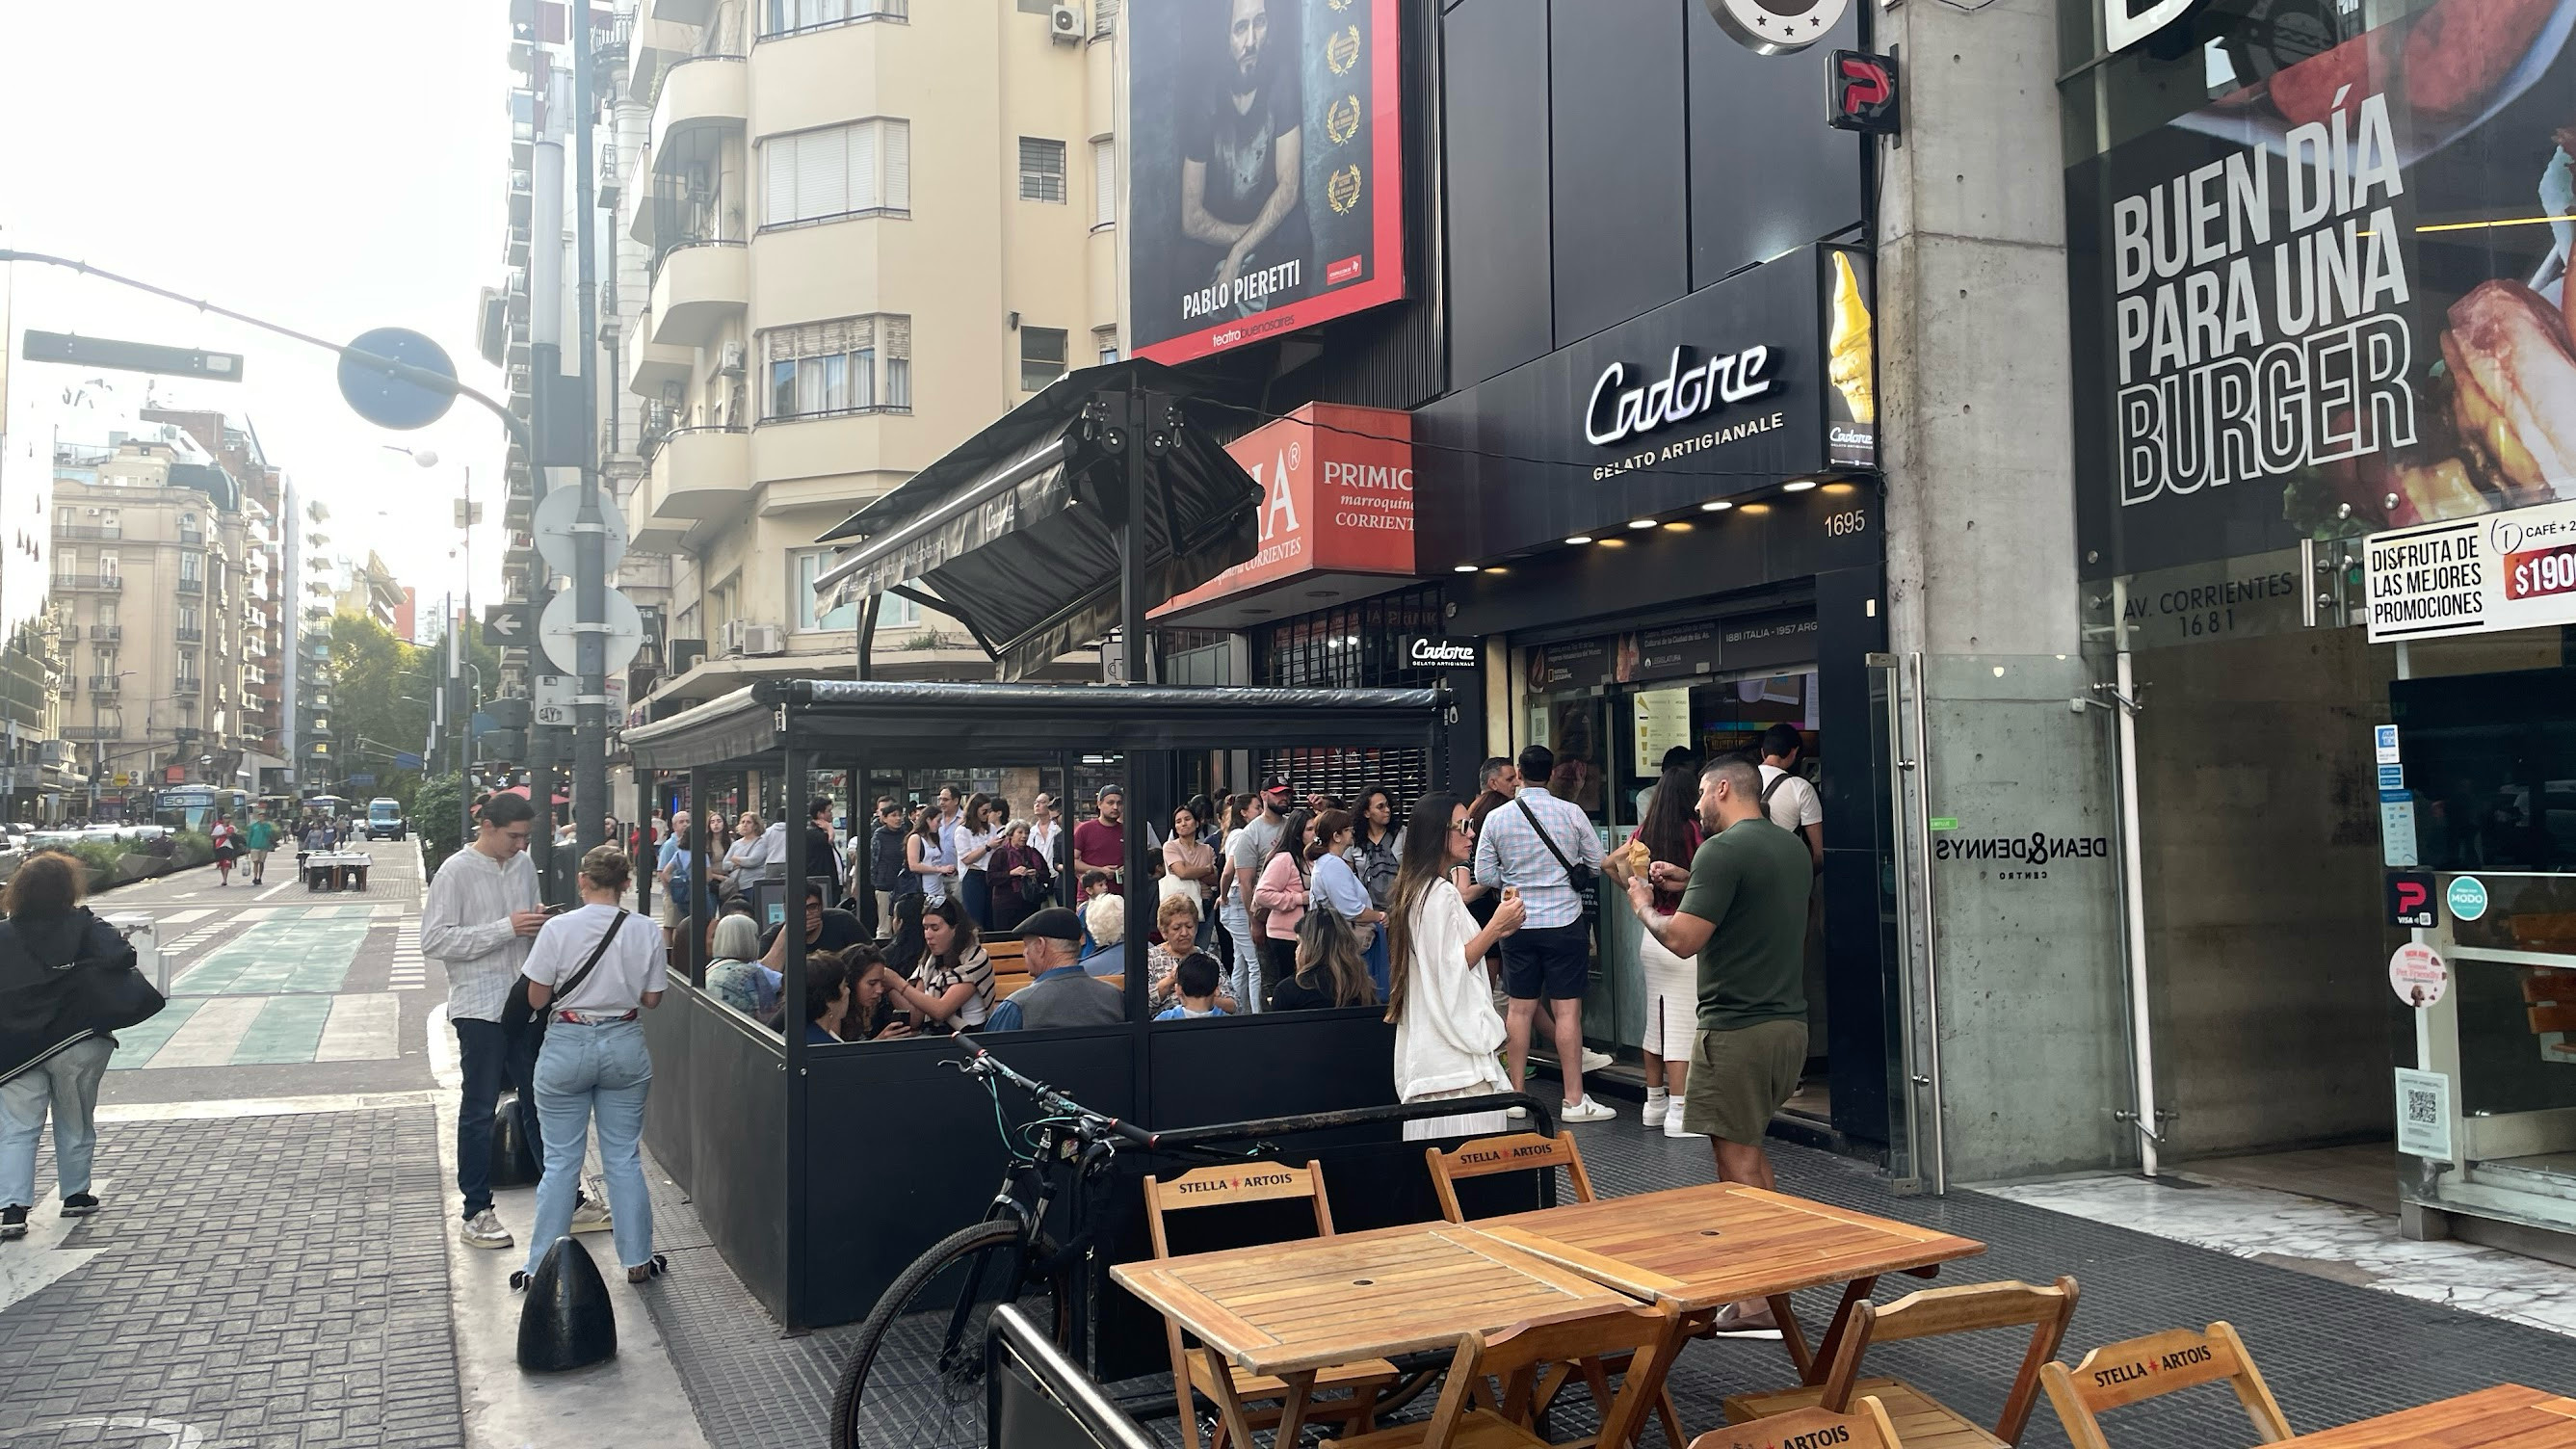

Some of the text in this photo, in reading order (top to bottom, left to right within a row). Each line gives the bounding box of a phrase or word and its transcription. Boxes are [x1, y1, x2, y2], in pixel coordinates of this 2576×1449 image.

[2114, 84, 2404, 294] BUEN DÍA
[1183, 258, 1301, 320] PABLO PIERETTI
[2117, 206, 2409, 384] PARA UNA
[1585, 345, 1771, 445] Cadore
[2117, 313, 2418, 506] BURGER
[1592, 411, 1784, 481] GELATO ARTIGIANALE
[1830, 426, 1874, 444] Cadore
[1324, 461, 1414, 490] PRIMIC
[1824, 509, 1866, 538] 1695
[2526, 523, 2558, 538] CAFÉ
[2372, 535, 2479, 572] DISFRUTA DE
[2123, 571, 2294, 620] AV. CORRIENTES
[2374, 562, 2482, 598] LAS MEJORES
[2375, 591, 2483, 624] PROMOCIONES
[1743, 628, 1770, 640] ITALIA
[1776, 624, 1796, 636] 1957
[1798, 621, 1818, 632] ARG
[2179, 609, 2234, 638] 1681
[1411, 638, 1475, 661] Cadore
[2451, 893, 2484, 904] MODO
[1460, 1144, 1553, 1165] STELLA ARTOIS
[1179, 1173, 1293, 1195] STELLA ARTOIS
[2094, 1345, 2212, 1387] STELLA ARTOIS
[1783, 1425, 1850, 1449] ARTOIS
